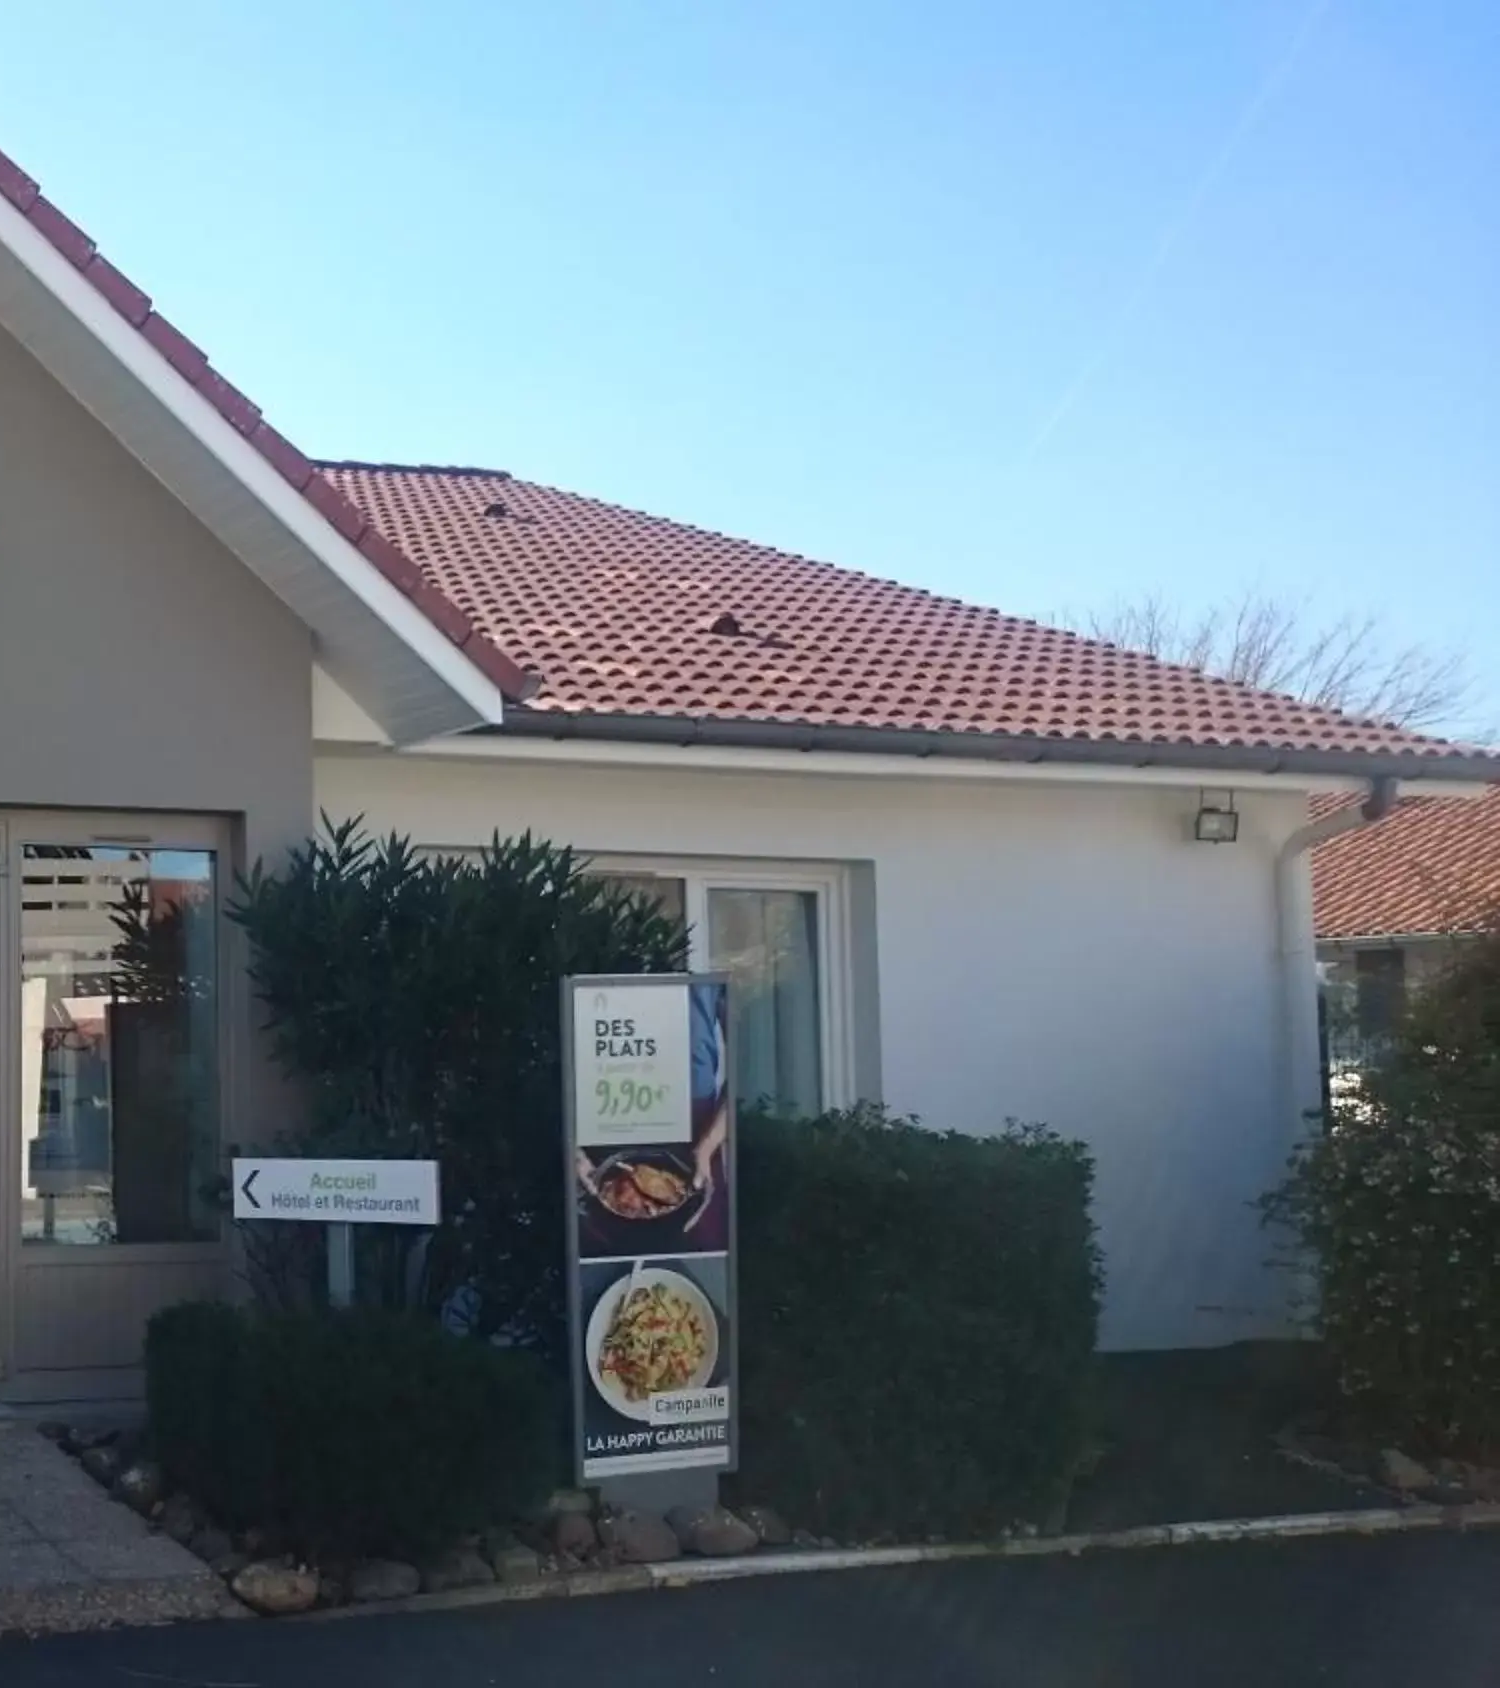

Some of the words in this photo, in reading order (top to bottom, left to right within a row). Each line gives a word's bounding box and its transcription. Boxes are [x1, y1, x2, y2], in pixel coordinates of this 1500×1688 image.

[595, 1019, 636, 1037] DES
[595, 1039, 658, 1057] PLATS
[309, 1173, 378, 1191] Accueil
[271, 1192, 312, 1209] Hôtel
[315, 1194, 330, 1209] et
[334, 1195, 420, 1212] Restaurant
[587, 1435, 605, 1451] LA
[606, 1431, 653, 1449] HAPPY
[655, 1426, 725, 1445] GARANTIE
